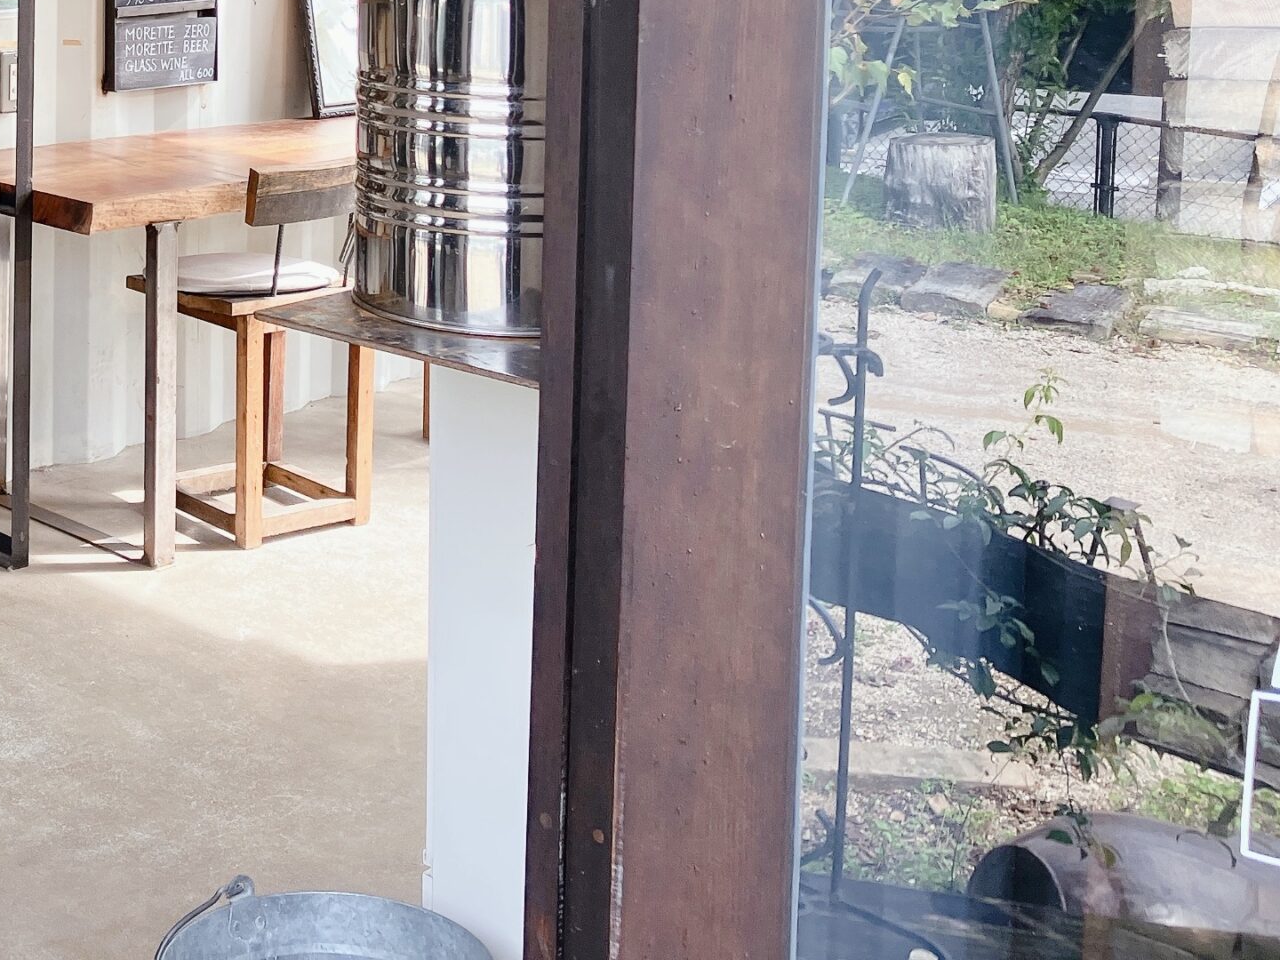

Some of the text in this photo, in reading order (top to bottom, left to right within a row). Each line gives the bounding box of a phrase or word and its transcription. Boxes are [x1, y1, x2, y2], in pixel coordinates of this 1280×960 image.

[125, 23, 210, 41] MORETTE ZERO
[125, 39, 210, 57] MORETTE BEER
[124, 56, 188, 72] GLASS WINE
[178, 68, 214, 82] ALL 600
